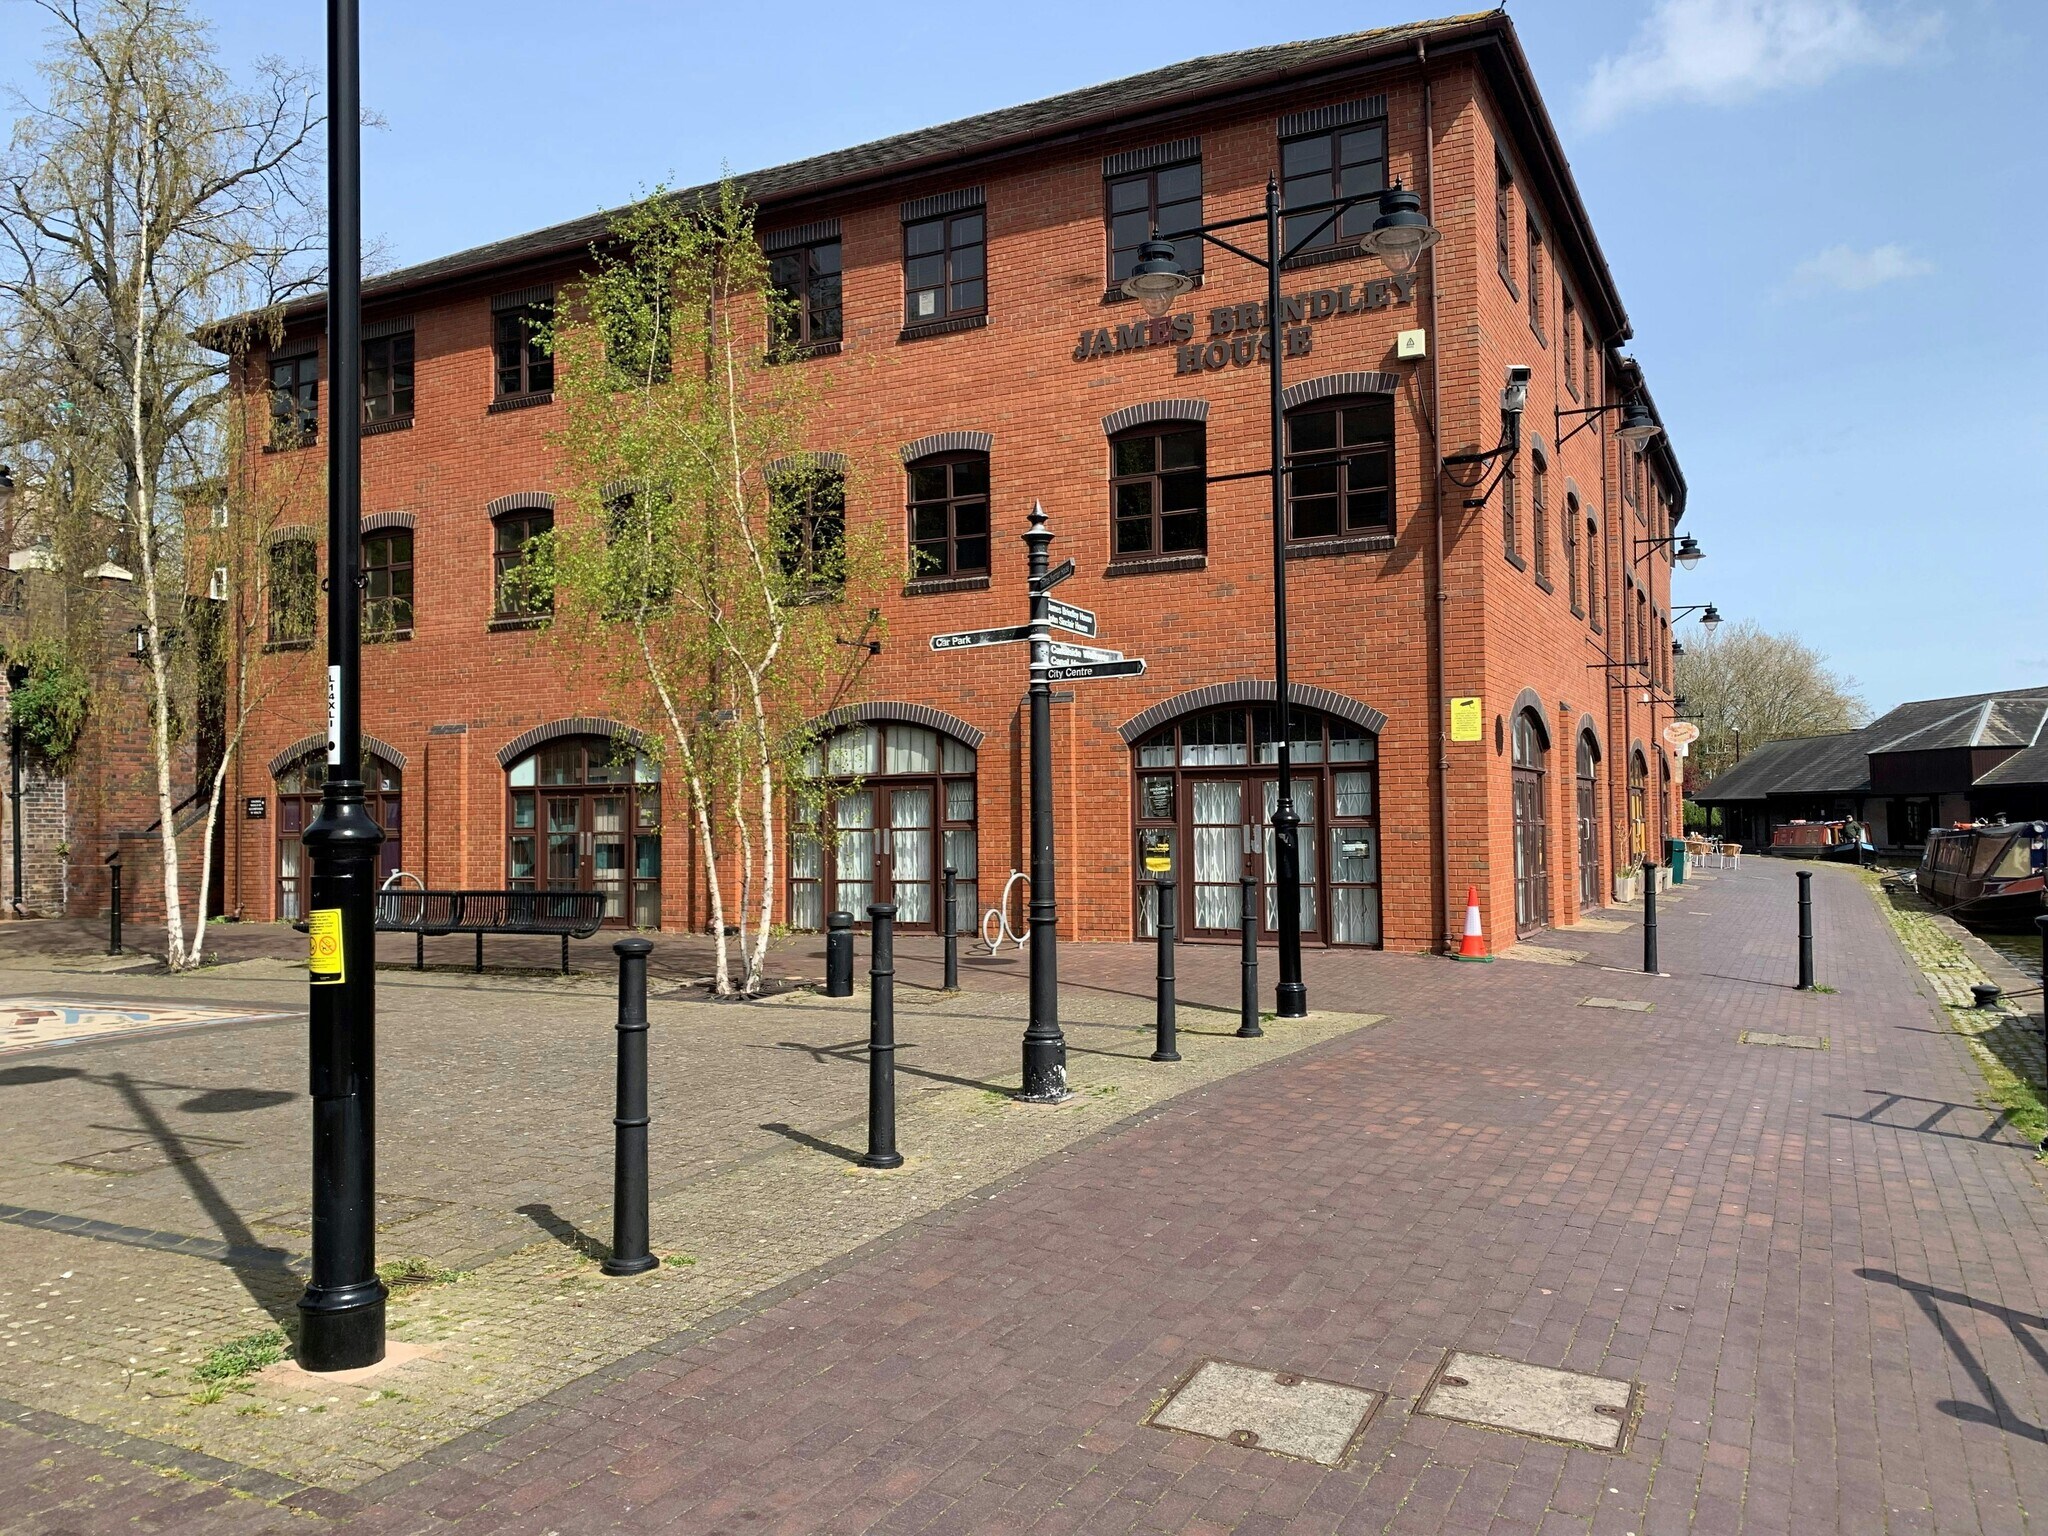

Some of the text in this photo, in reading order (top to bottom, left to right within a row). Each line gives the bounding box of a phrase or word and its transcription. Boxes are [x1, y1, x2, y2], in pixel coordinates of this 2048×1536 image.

[1074, 313, 1194, 359] JAMES
[1079, 612, 1093, 623] House
[1075, 621, 1089, 633] House
[935, 635, 971, 647] Car Park
[1048, 668, 1093, 679] City Centre
